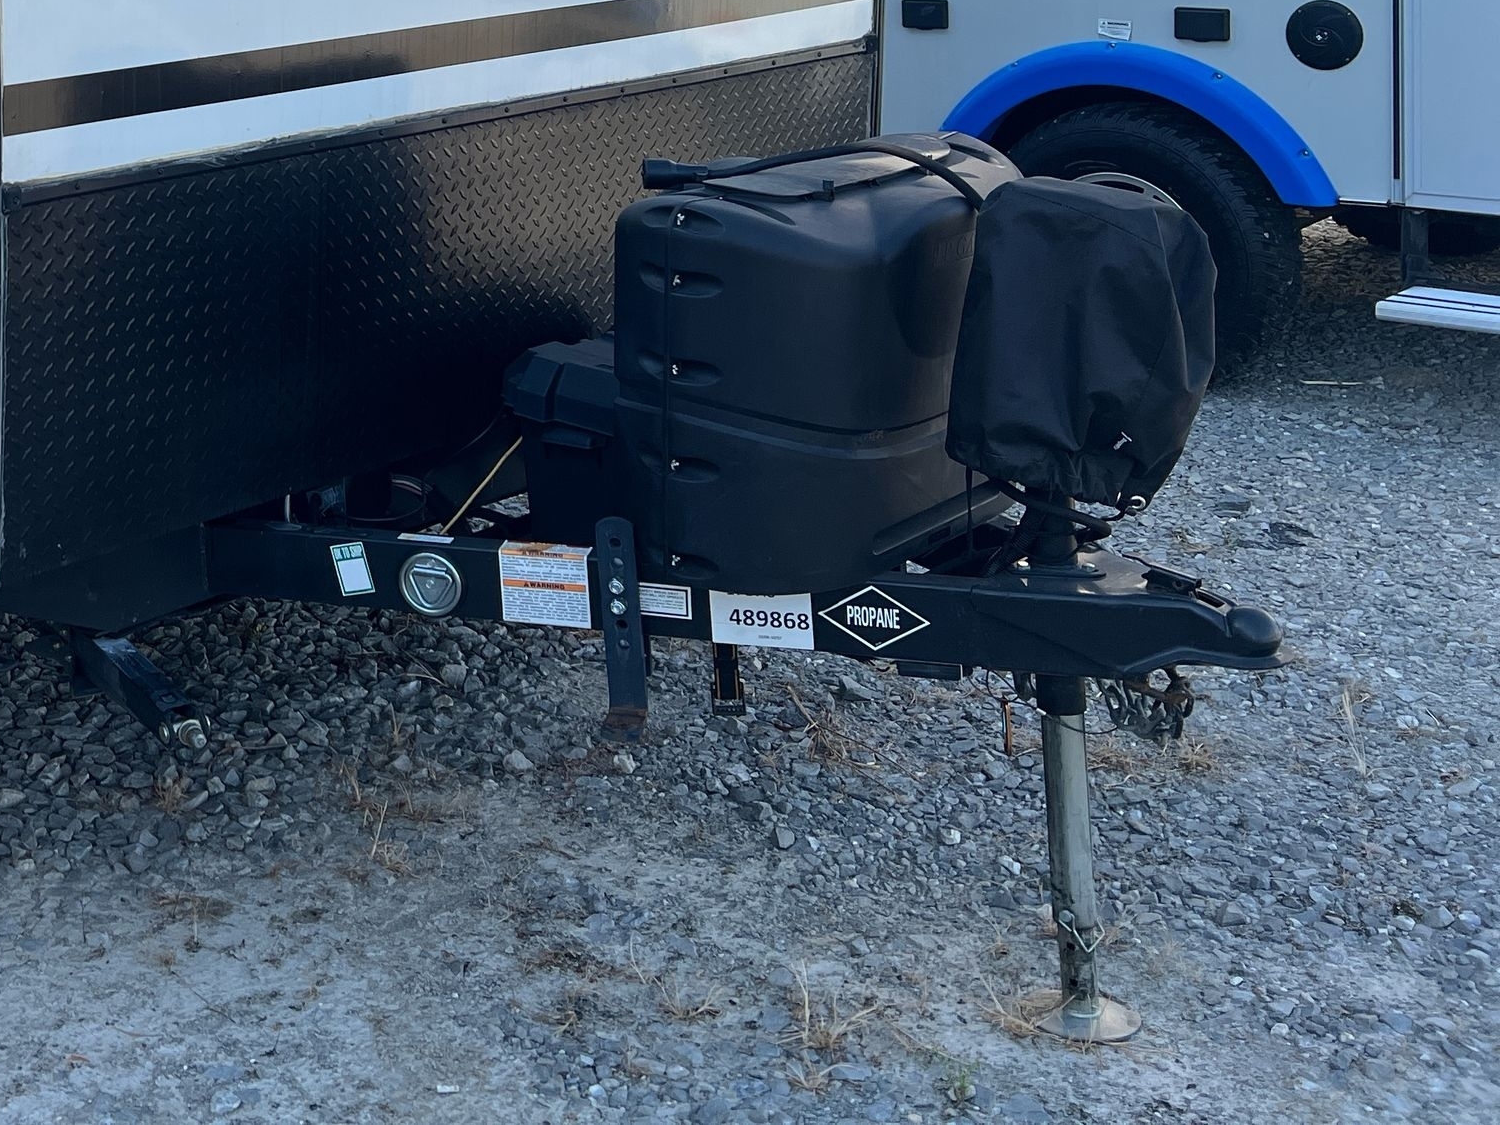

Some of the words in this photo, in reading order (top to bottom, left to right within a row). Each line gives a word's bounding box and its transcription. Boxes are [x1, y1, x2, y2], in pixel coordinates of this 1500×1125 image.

[530, 581, 565, 590] WARNING
[729, 608, 810, 631] 489868
[846, 605, 900, 630] PROPANE
